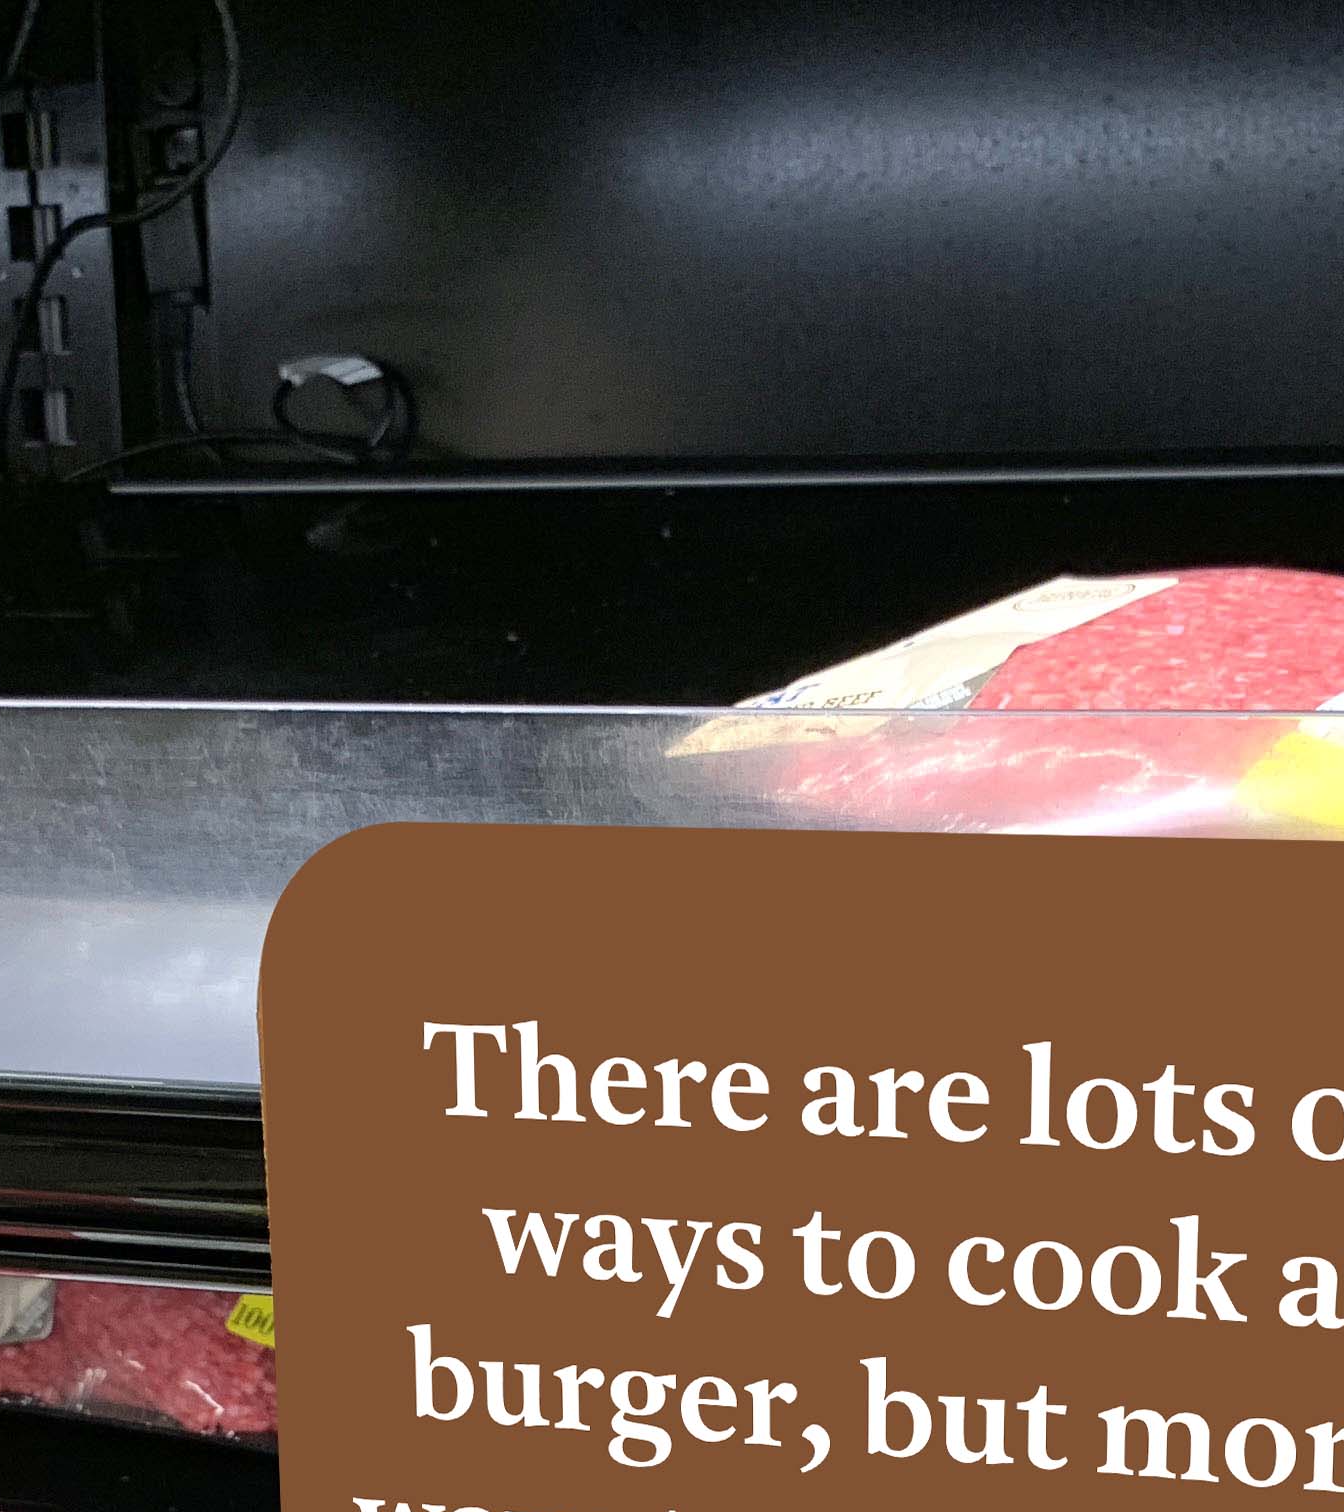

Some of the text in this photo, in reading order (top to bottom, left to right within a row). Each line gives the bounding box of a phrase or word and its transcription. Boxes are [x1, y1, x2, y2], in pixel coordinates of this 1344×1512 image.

[423, 1020, 770, 1131] There
[801, 1065, 990, 1142] are
[1020, 1041, 1256, 1156] lots
[482, 1208, 763, 1318] ways
[792, 1210, 916, 1299] to
[948, 1214, 1248, 1322] cook
[407, 1323, 830, 1472] burger,
[860, 1357, 1068, 1470] but
